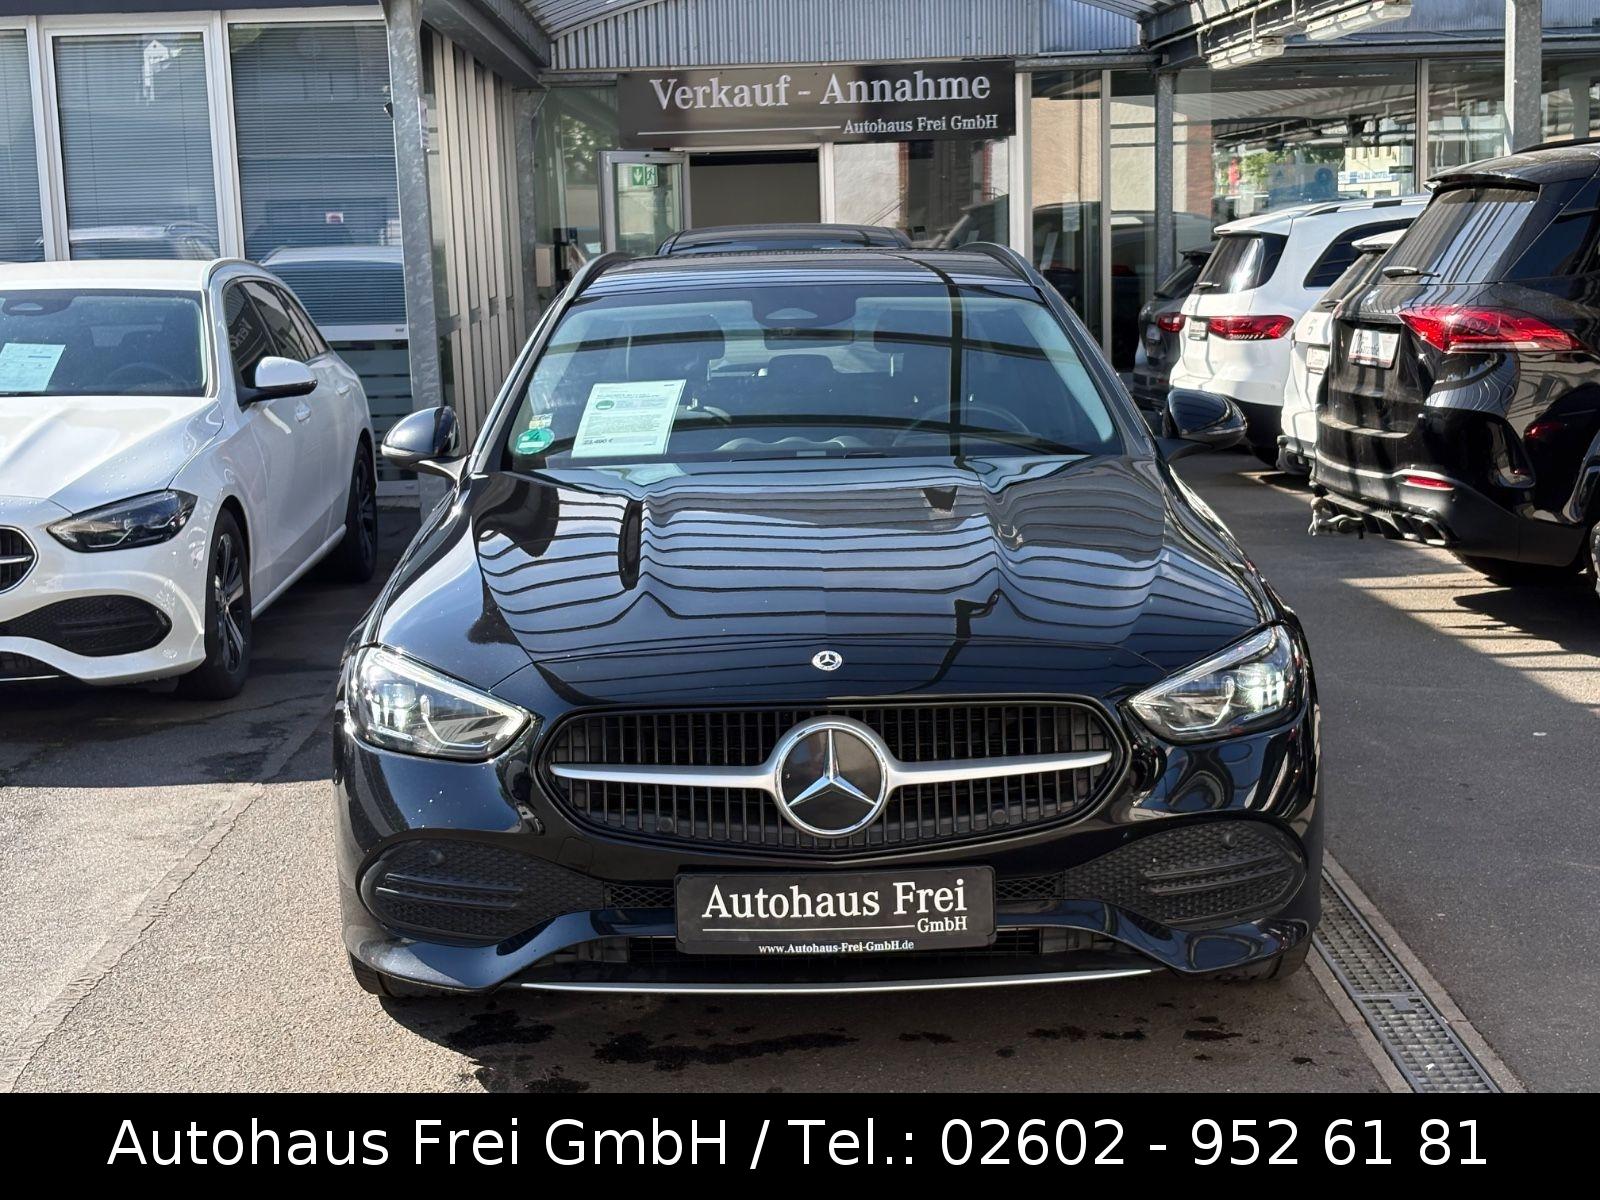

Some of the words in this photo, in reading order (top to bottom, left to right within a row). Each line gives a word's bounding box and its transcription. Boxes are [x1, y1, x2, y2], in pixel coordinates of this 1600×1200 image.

[649, 74, 791, 110] Verkauf
[819, 70, 991, 105] Annahme
[843, 118, 913, 135] Autohaus
[916, 116, 946, 132] Frei
[950, 114, 998, 131] GmbH
[701, 883, 881, 919] Autohaus
[892, 878, 968, 916] Frei
[916, 915, 968, 934] GmbH
[758, 939, 915, 955] www.Autohaus-Frei-GmbH.de
